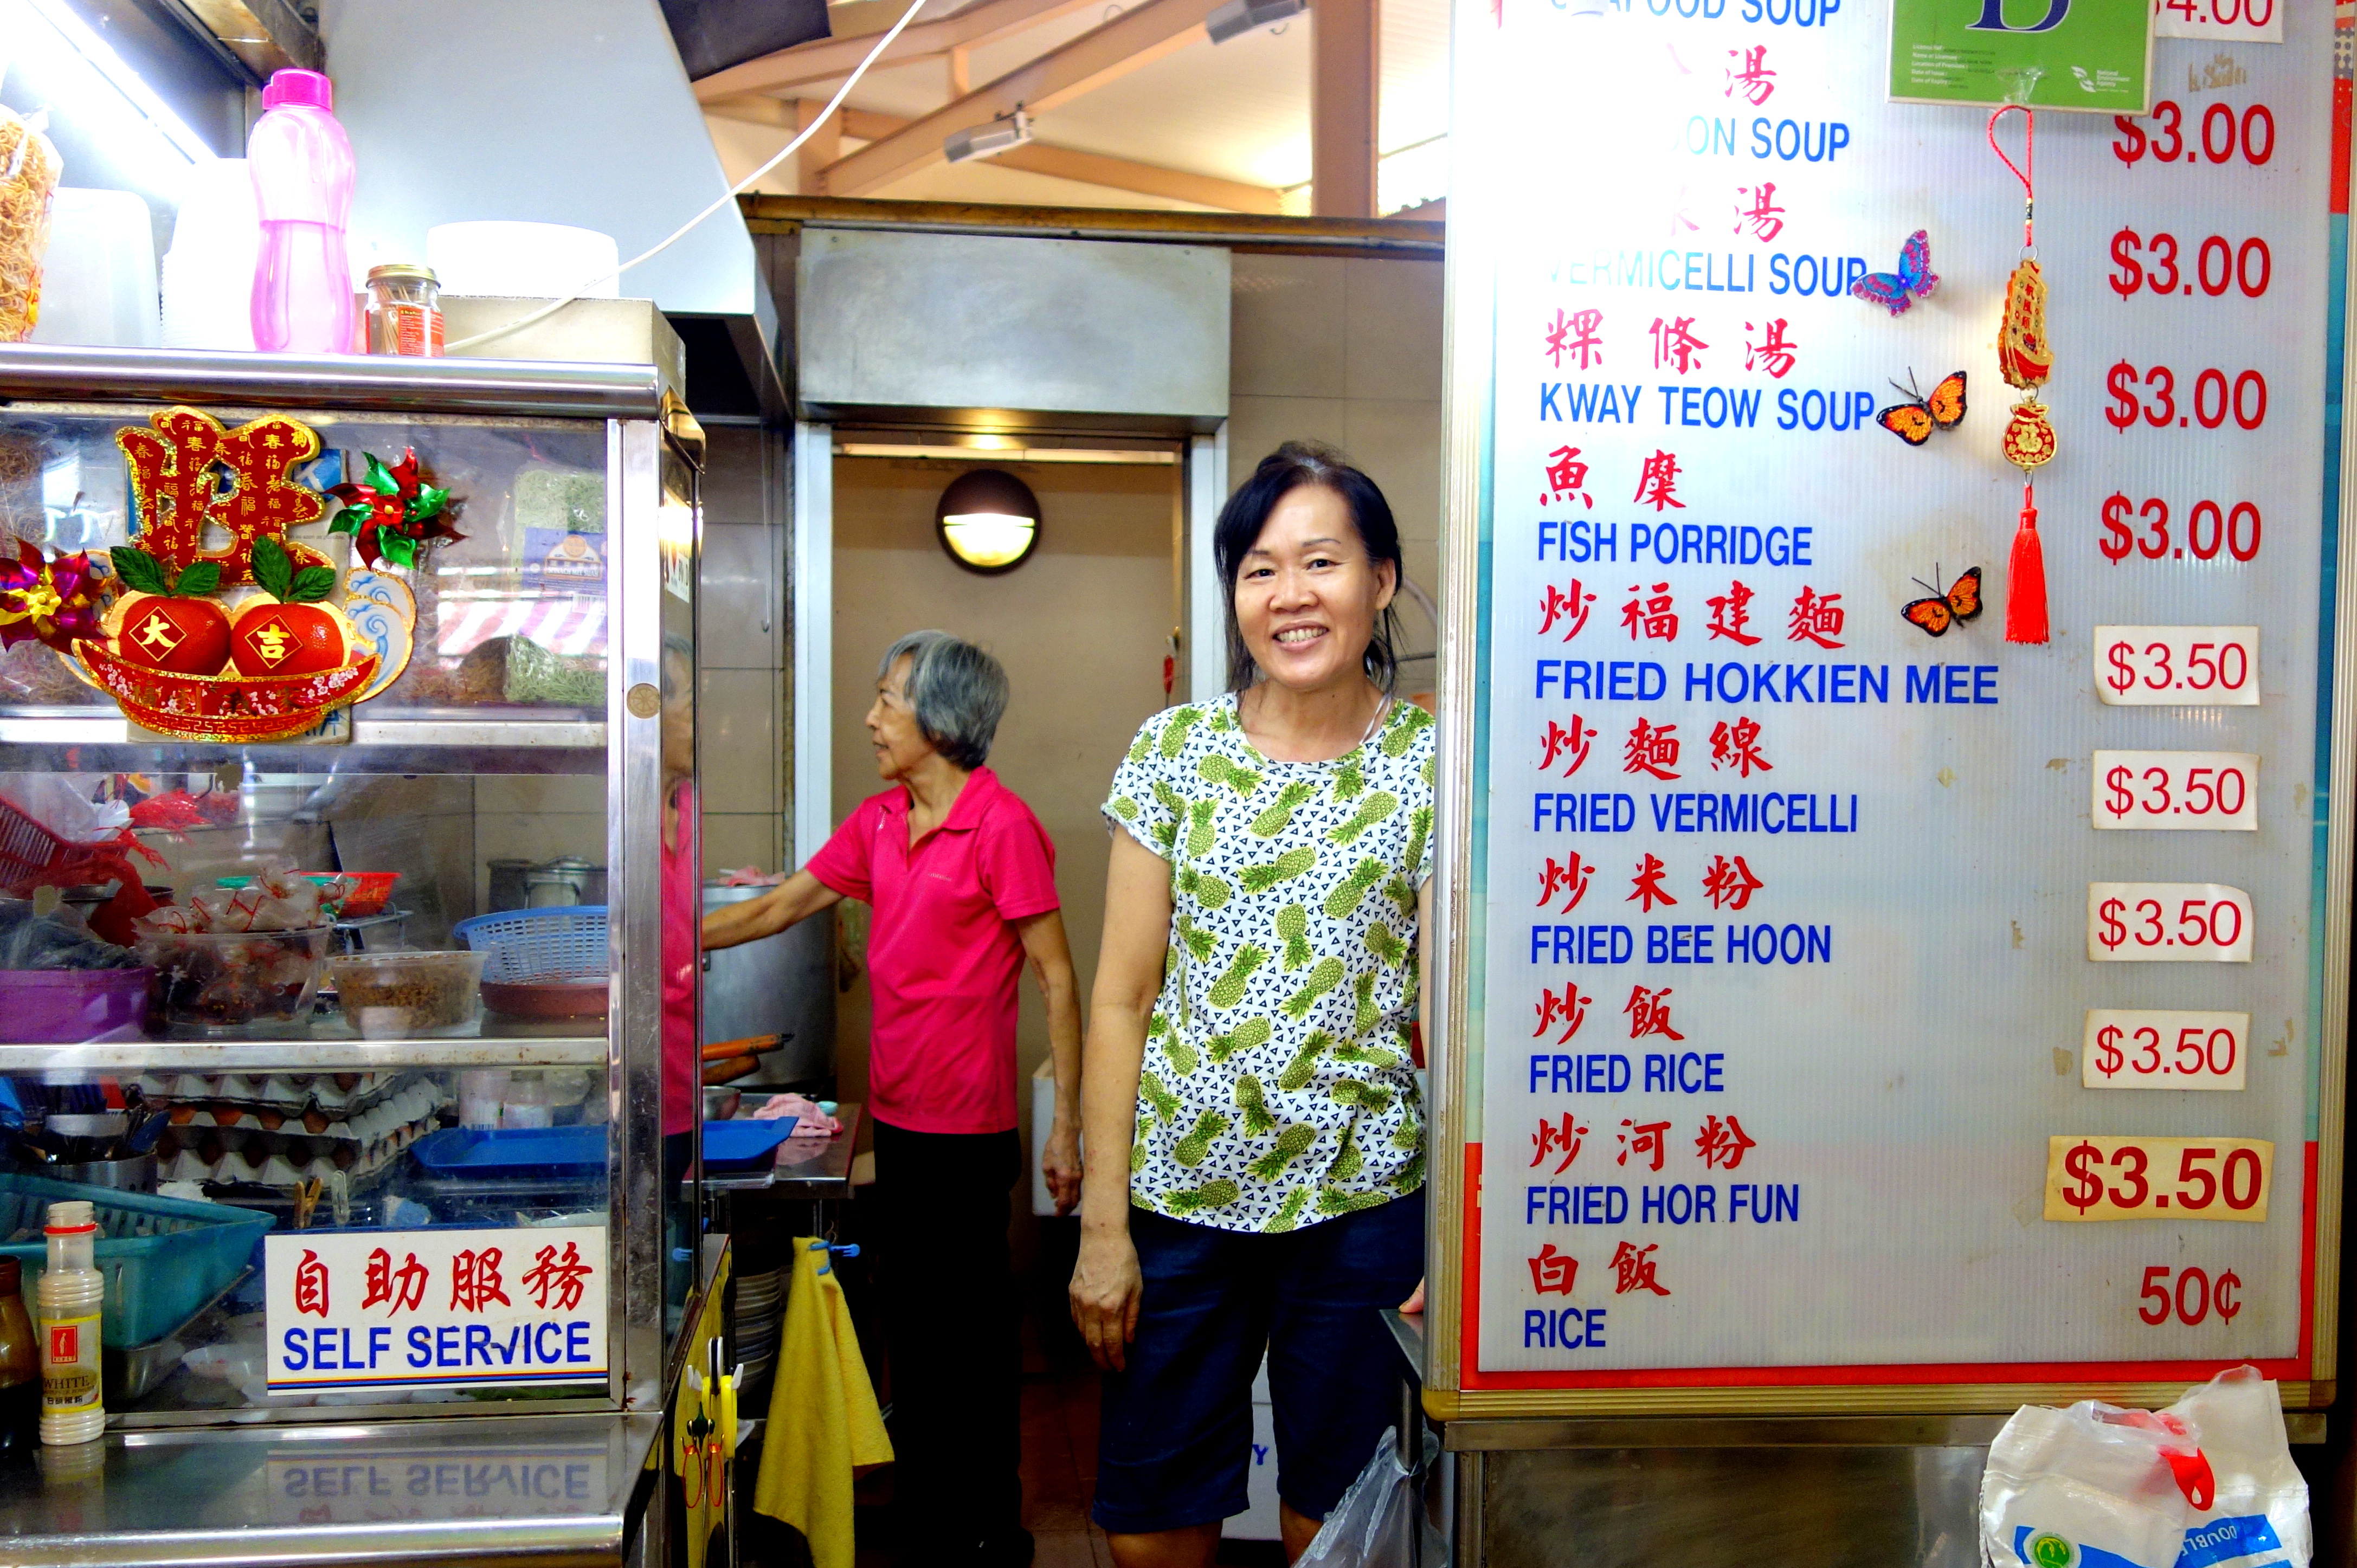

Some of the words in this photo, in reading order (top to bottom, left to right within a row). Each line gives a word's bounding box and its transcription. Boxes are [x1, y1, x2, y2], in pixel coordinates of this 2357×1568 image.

[1742, 0, 1841, 27] SOUP
[2155, 0, 2274, 27] 4.00
[1751, 118, 1850, 162] SOUP
[2113, 100, 2276, 167] $3.00
[1548, 249, 1754, 292] VERMICELLI
[1769, 253, 1866, 297] SOUP
[2109, 227, 2272, 300] $3.00
[1541, 383, 1642, 423] KWAY
[1658, 386, 1762, 429] TEOW
[1777, 388, 1874, 431] SOUP
[2105, 359, 2268, 433] $3.00
[1538, 520, 1618, 563] FISH
[1630, 522, 1814, 568] PORRIDGE
[2099, 492, 2262, 565] $3.00
[140, 615, 176, 648] 大
[256, 624, 290, 659] 吉
[1540, 579, 1845, 649] 炒福建麵
[1534, 657, 1669, 702] FRIED
[1683, 660, 1889, 705] HOKKIEN
[1905, 664, 1999, 705] MEE
[2107, 641, 2248, 695] $3.50
[1540, 714, 1773, 780] 炒麵線
[1532, 791, 1636, 833] FRIED
[1649, 791, 1858, 835] VERMICELLI
[2105, 765, 2246, 820] $3.50
[1538, 851, 1764, 914] 炒米粉
[1530, 924, 1634, 965] FRIED
[1646, 924, 1715, 964] BEE
[1726, 922, 1832, 965] HOON
[2097, 897, 2243, 952] $3.50
[1534, 982, 1684, 1044] 炒飯
[1529, 1054, 1631, 1093] FRIED
[1644, 1052, 1724, 1094] RICE
[2094, 1024, 2236, 1080] $3.50
[1530, 1112, 1756, 1175] 炒河粉
[1527, 1185, 1628, 1224] FRIED
[1642, 1184, 1716, 1224] HOR
[1729, 1184, 1799, 1223] FUN
[2058, 1139, 2264, 1217] $3.50
[294, 1241, 594, 1318] 自助服務
[1528, 1241, 1671, 1296] 白飯
[2138, 1266, 2242, 1326] 50¢
[284, 1327, 391, 1370] SELF
[407, 1321, 590, 1368] SERVICE
[1524, 1308, 1606, 1349] RICE
[44, 1376, 89, 1390] WHITE
